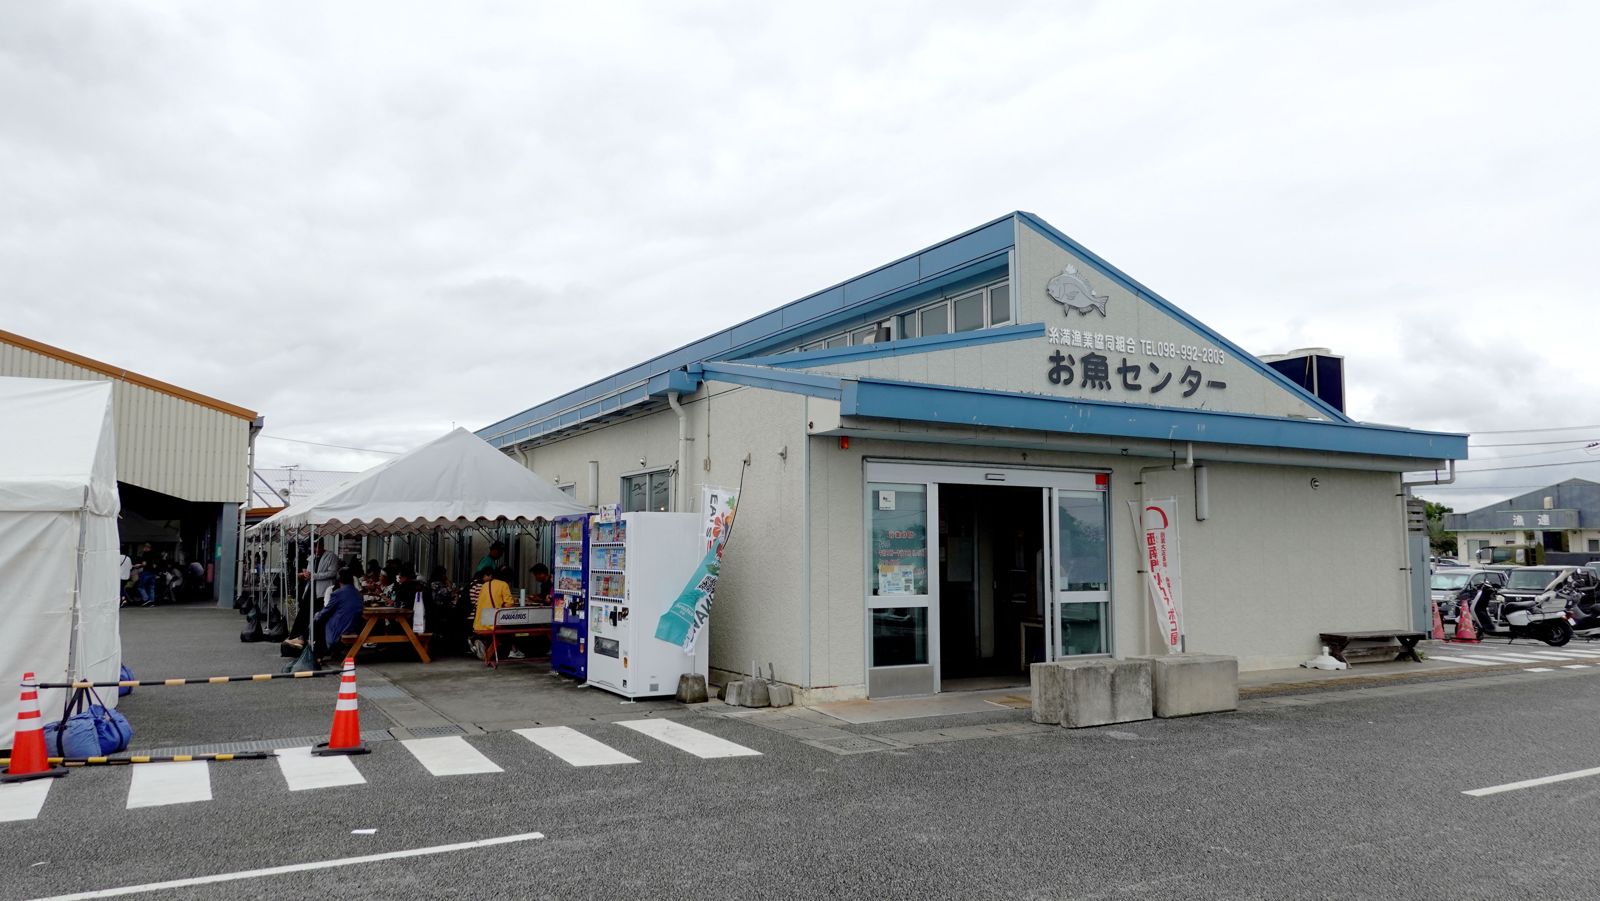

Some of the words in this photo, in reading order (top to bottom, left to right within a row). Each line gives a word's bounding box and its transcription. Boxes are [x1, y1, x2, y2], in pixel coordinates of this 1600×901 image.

[1048, 327, 1136, 354] 糸満漁業協同組合
[1048, 350, 1227, 398] お魚センター
